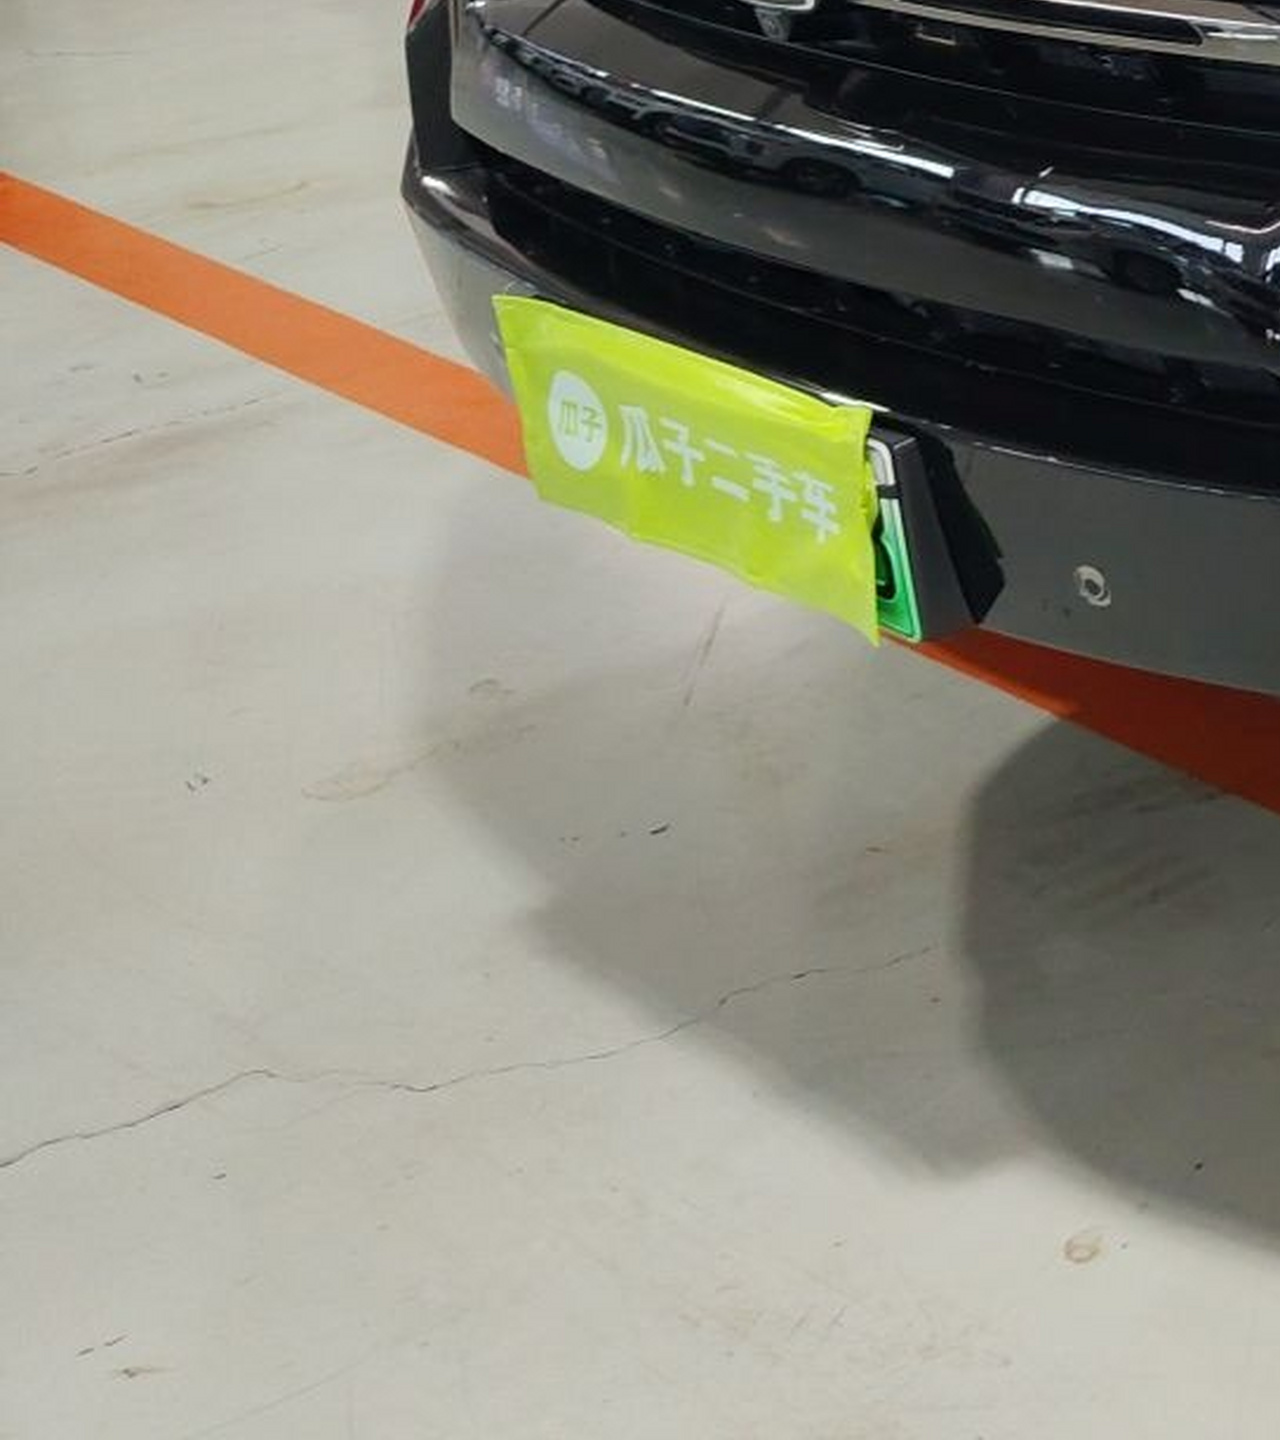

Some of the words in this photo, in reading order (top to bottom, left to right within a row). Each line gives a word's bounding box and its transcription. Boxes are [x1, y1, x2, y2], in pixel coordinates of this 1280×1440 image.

[617, 404, 841, 544] 瓜子二手车
